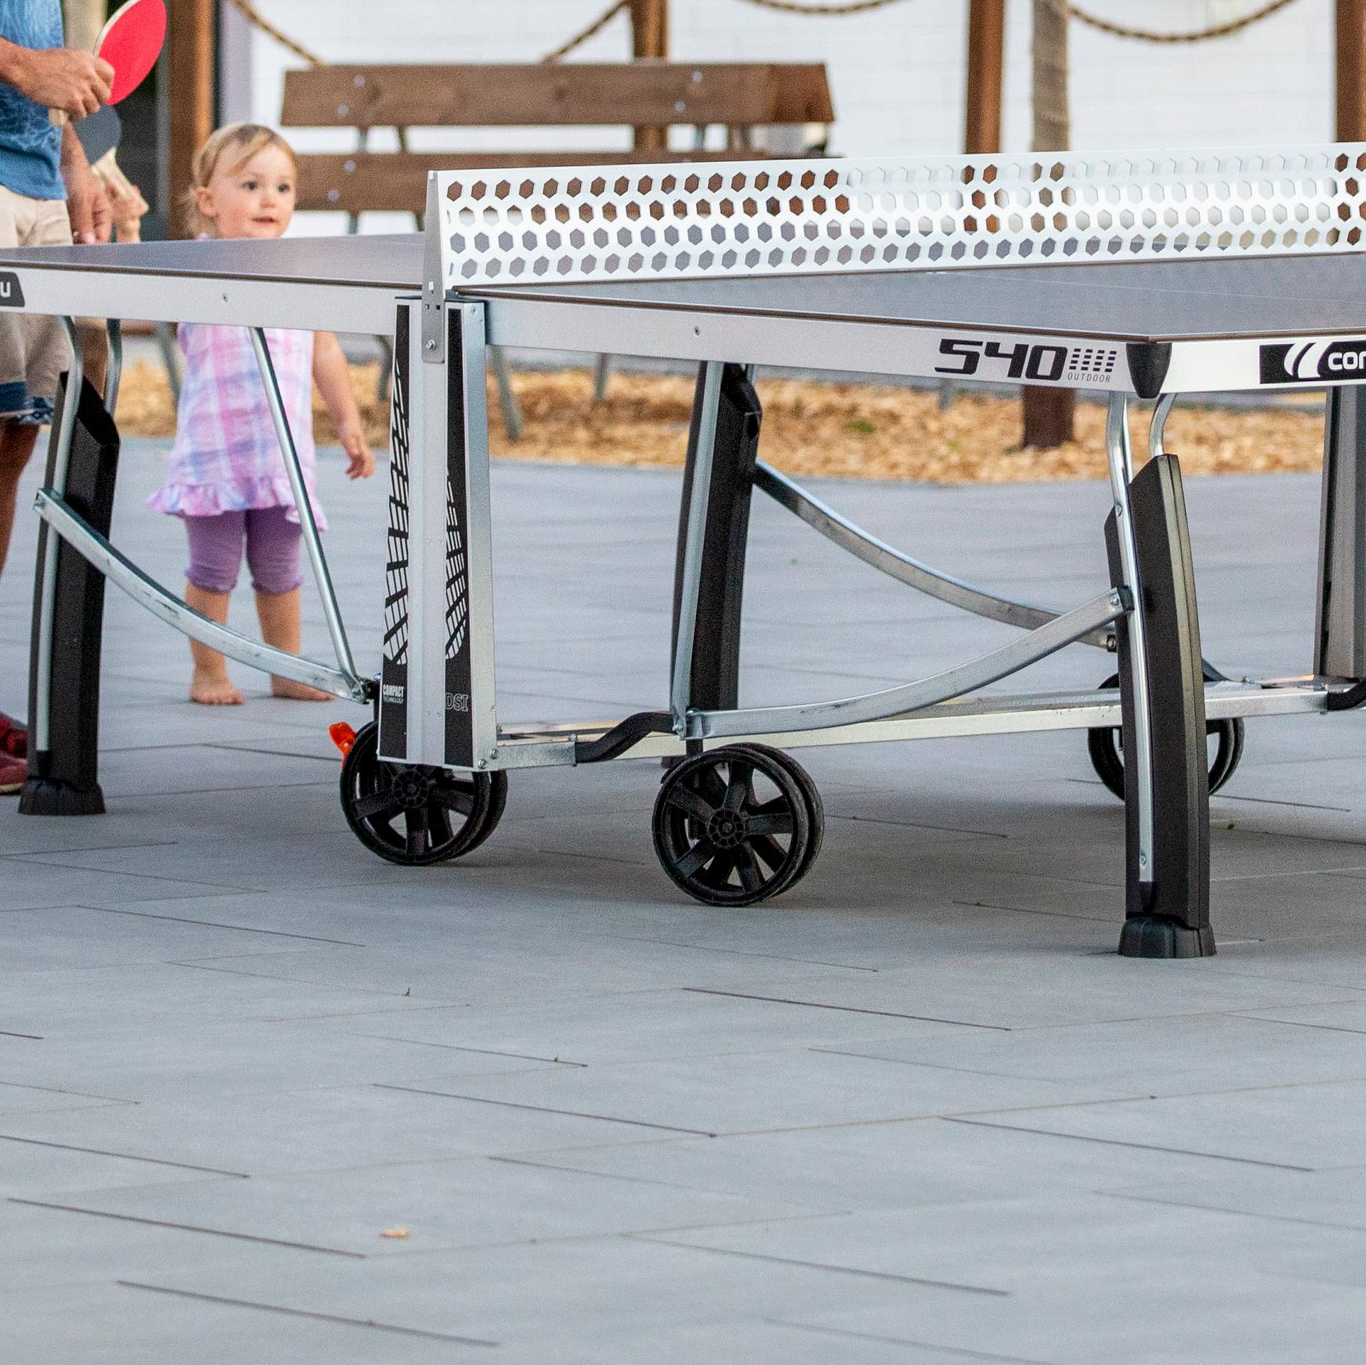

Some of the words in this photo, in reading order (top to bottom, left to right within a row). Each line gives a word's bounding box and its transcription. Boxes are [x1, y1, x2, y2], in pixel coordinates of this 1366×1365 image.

[934, 339, 1068, 381] 540
[1067, 372, 1111, 383] OUTDOOR
[445, 692, 468, 712] DSI
